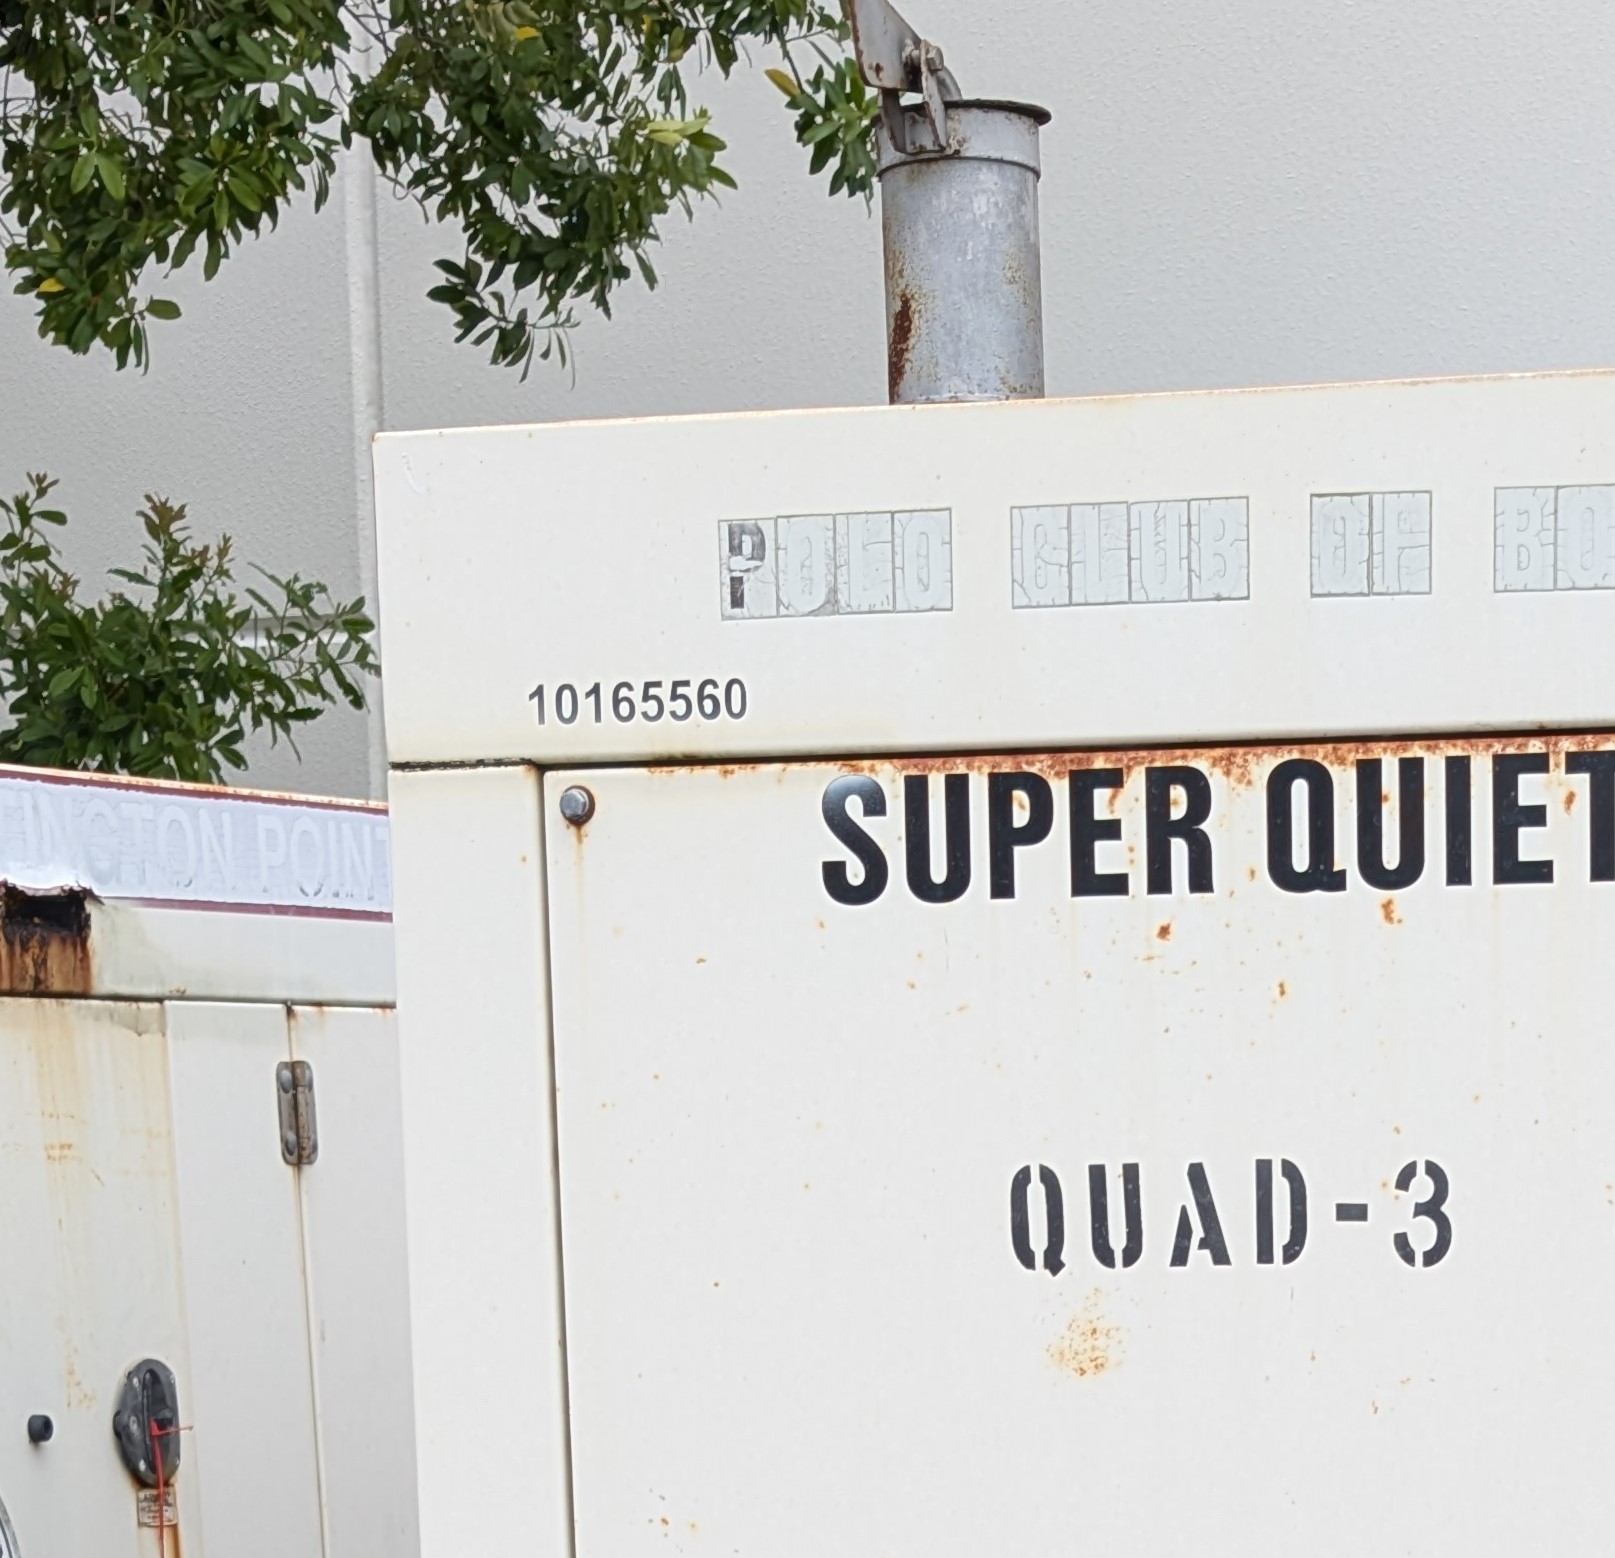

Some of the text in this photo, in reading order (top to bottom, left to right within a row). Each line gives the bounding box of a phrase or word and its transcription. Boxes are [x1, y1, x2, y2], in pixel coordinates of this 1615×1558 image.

[527, 677, 748, 726] 10165560
[820, 764, 1216, 906] SUPER
[1009, 1157, 1453, 1278] QUAD-3
